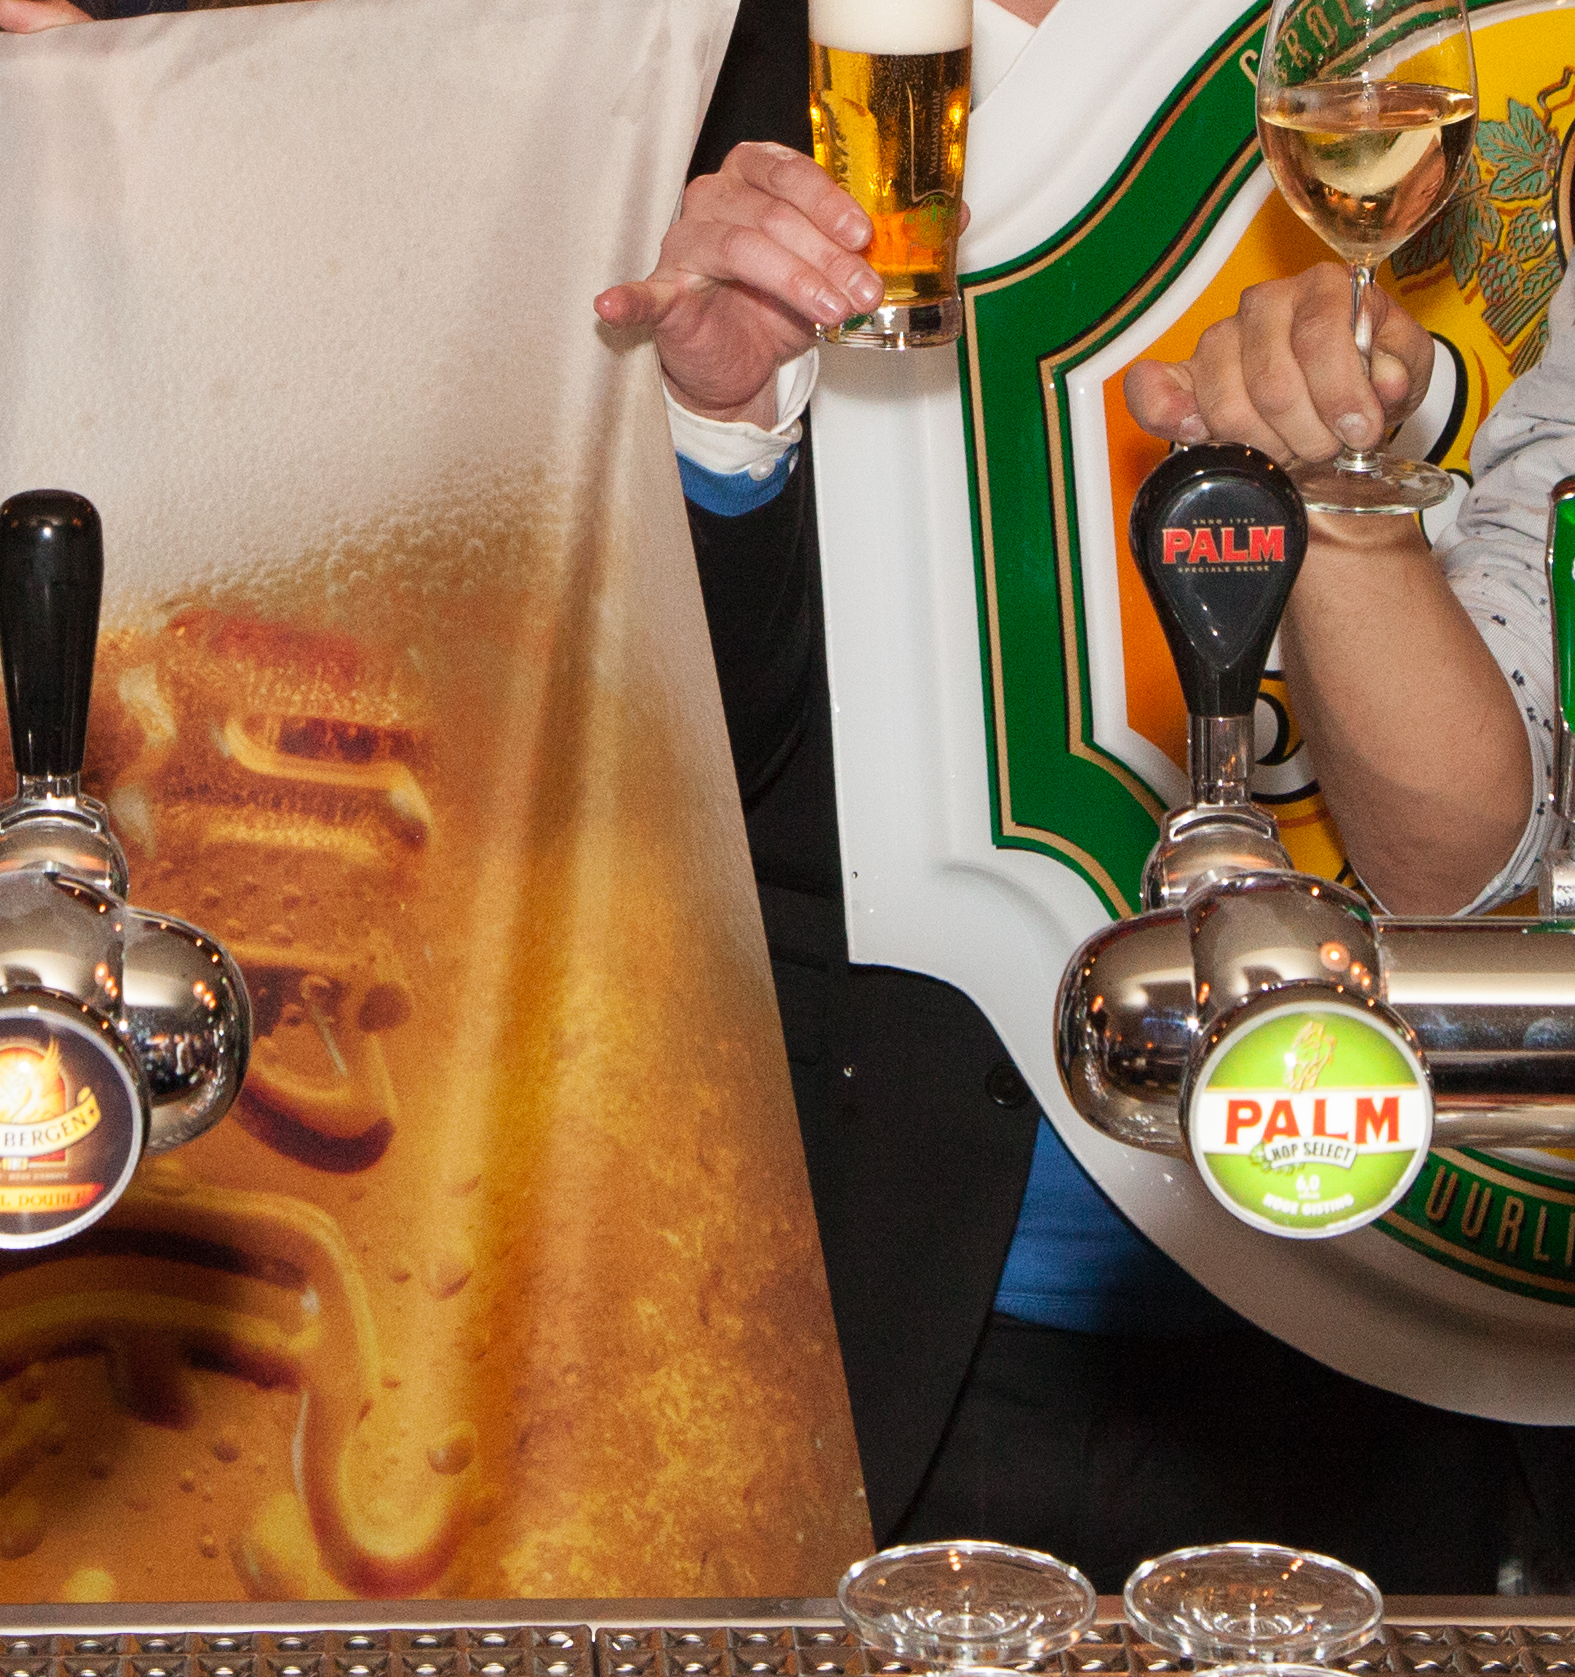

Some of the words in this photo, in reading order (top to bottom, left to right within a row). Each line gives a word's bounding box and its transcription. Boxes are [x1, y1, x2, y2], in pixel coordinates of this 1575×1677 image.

[1162, 525, 1286, 564] PALM
[1224, 1095, 1400, 1145] PALM
[1271, 1143, 1298, 1160] HOP
[1303, 1141, 1352, 1161] SELECT
